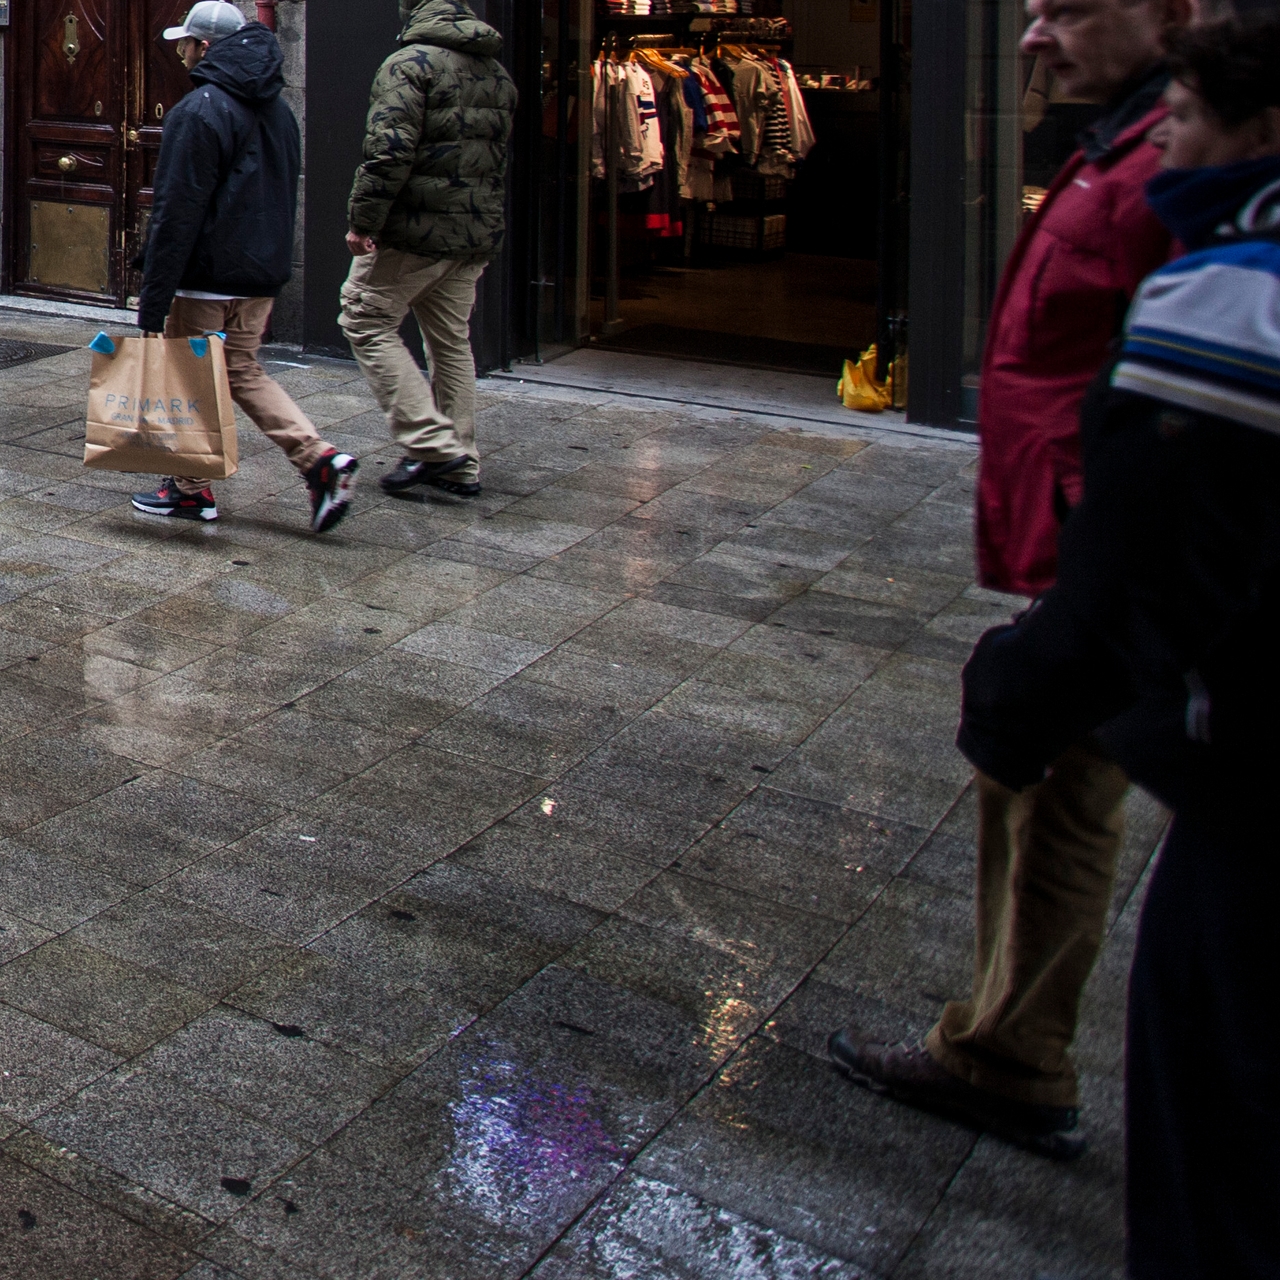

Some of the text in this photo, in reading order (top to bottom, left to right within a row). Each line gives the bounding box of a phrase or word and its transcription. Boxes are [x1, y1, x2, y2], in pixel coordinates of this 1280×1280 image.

[104, 393, 201, 414] PRIMARK
[111, 412, 134, 423] GRAN
[157, 416, 195, 426] MADRID
